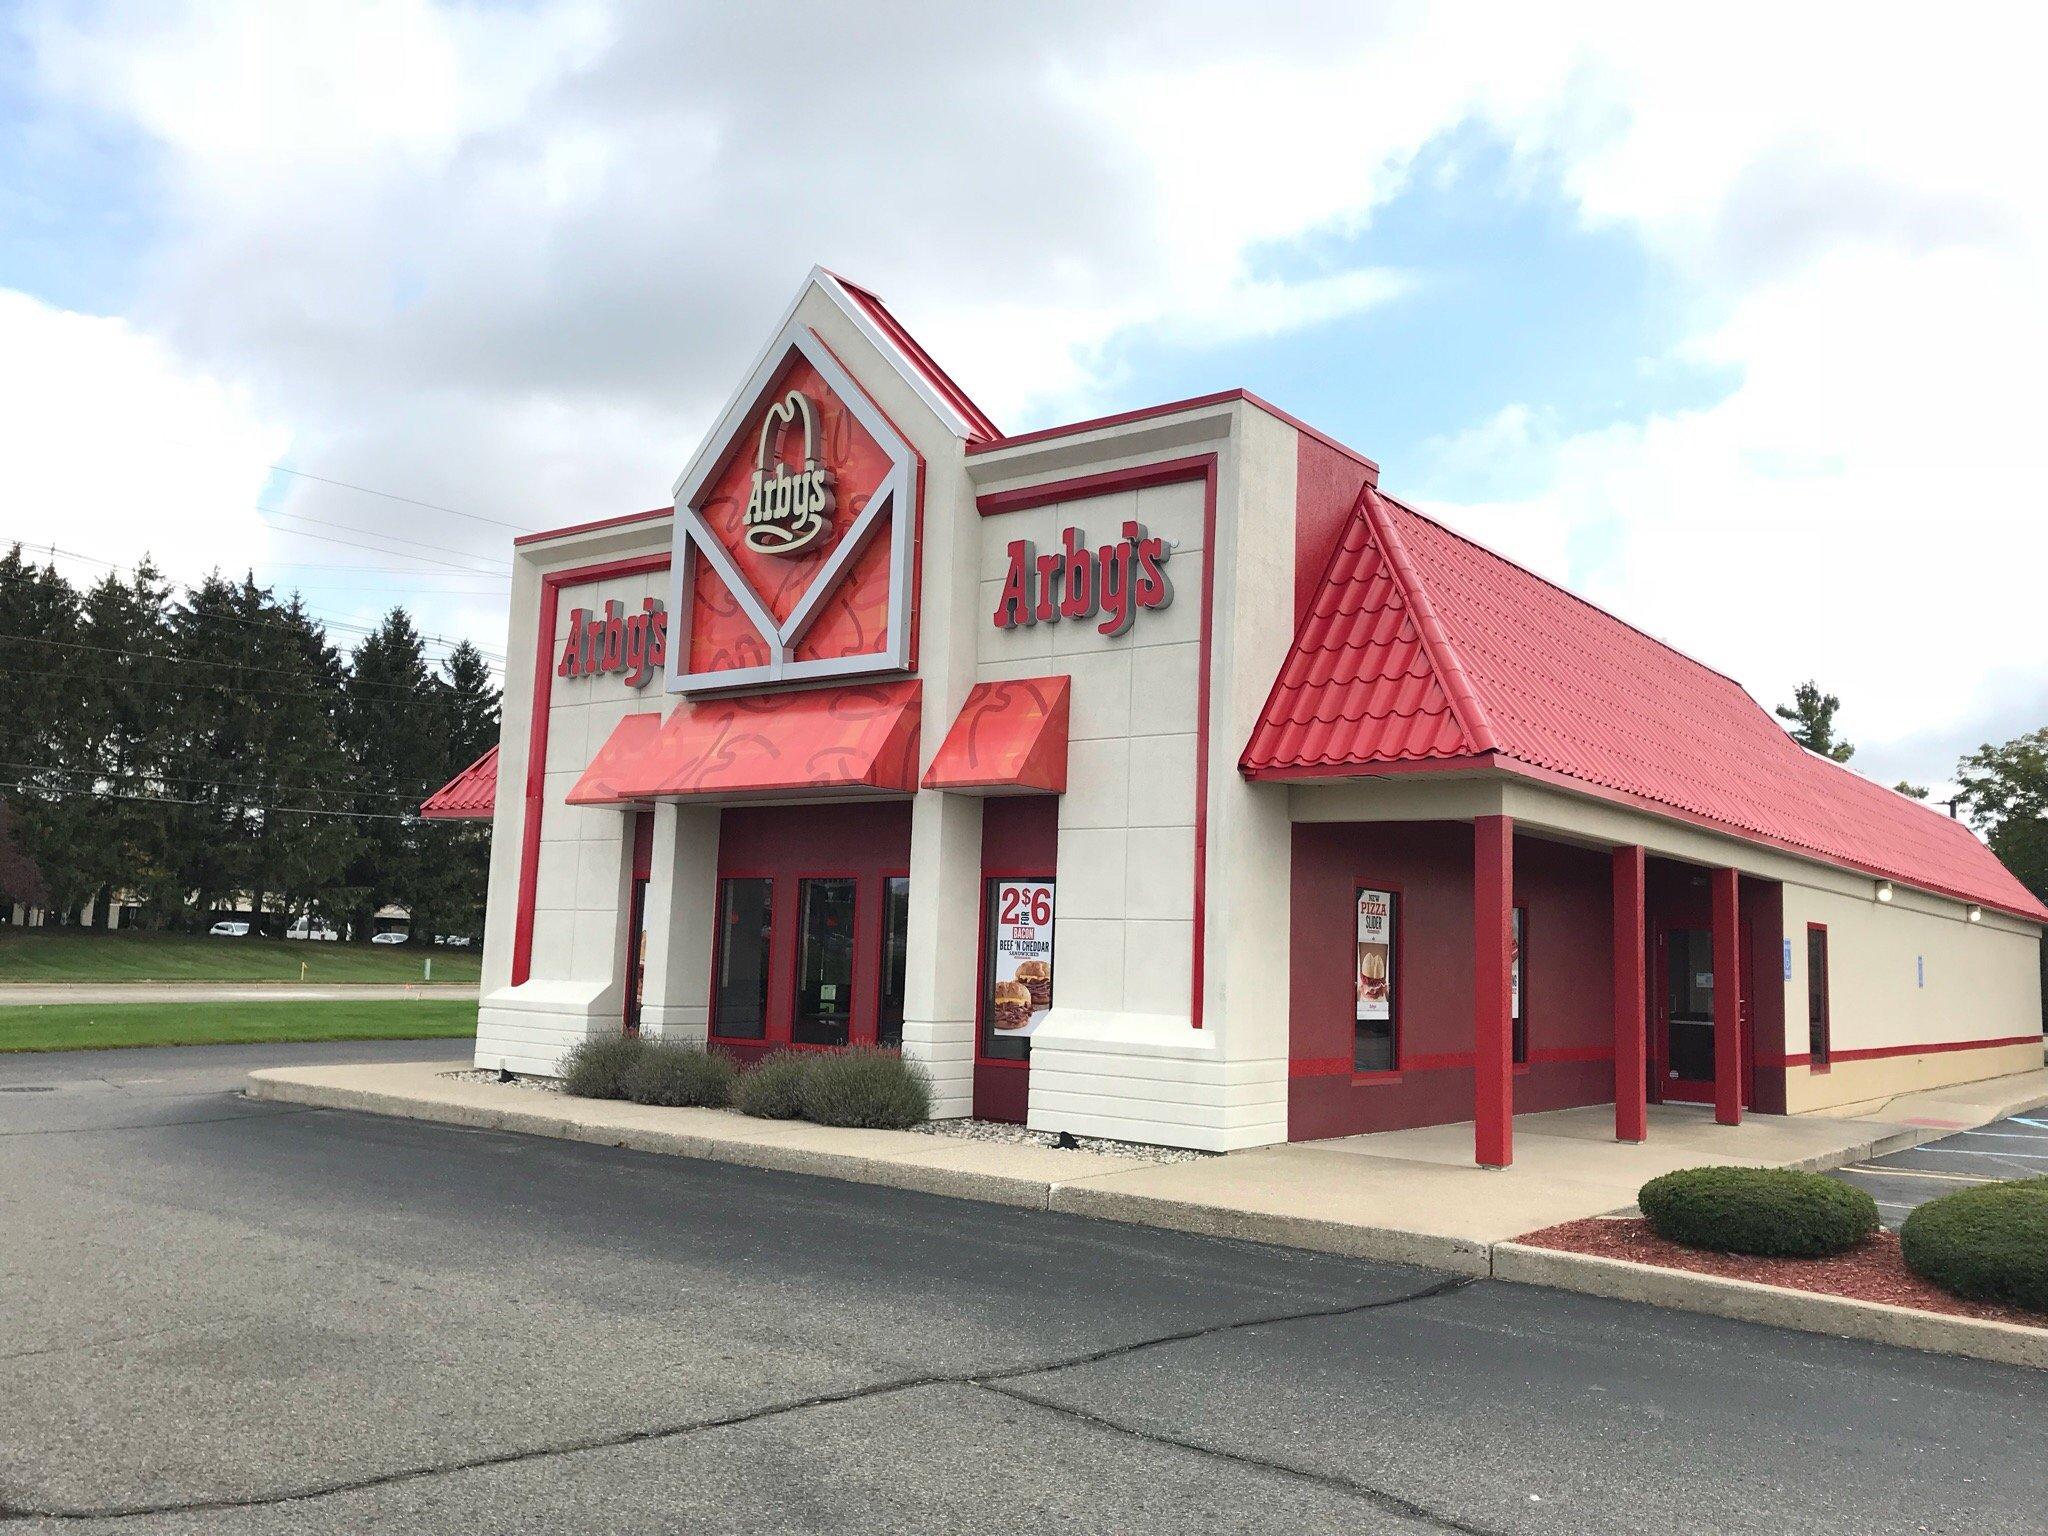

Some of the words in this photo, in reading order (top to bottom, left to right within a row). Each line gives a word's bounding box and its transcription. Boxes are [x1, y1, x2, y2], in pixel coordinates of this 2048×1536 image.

[742, 460, 828, 530] Arby's
[993, 521, 1172, 637] Arby's
[558, 597, 668, 689] Arby's
[1001, 887, 1020, 925] 2
[1021, 911, 1030, 926] FOR
[1360, 901, 1387, 916] PIZZA
[1013, 927, 1034, 939] BACON
[1365, 914, 1382, 930] SLIDER
[1000, 940, 1014, 950] BEEF
[1022, 941, 1049, 952] CHEDDAR
